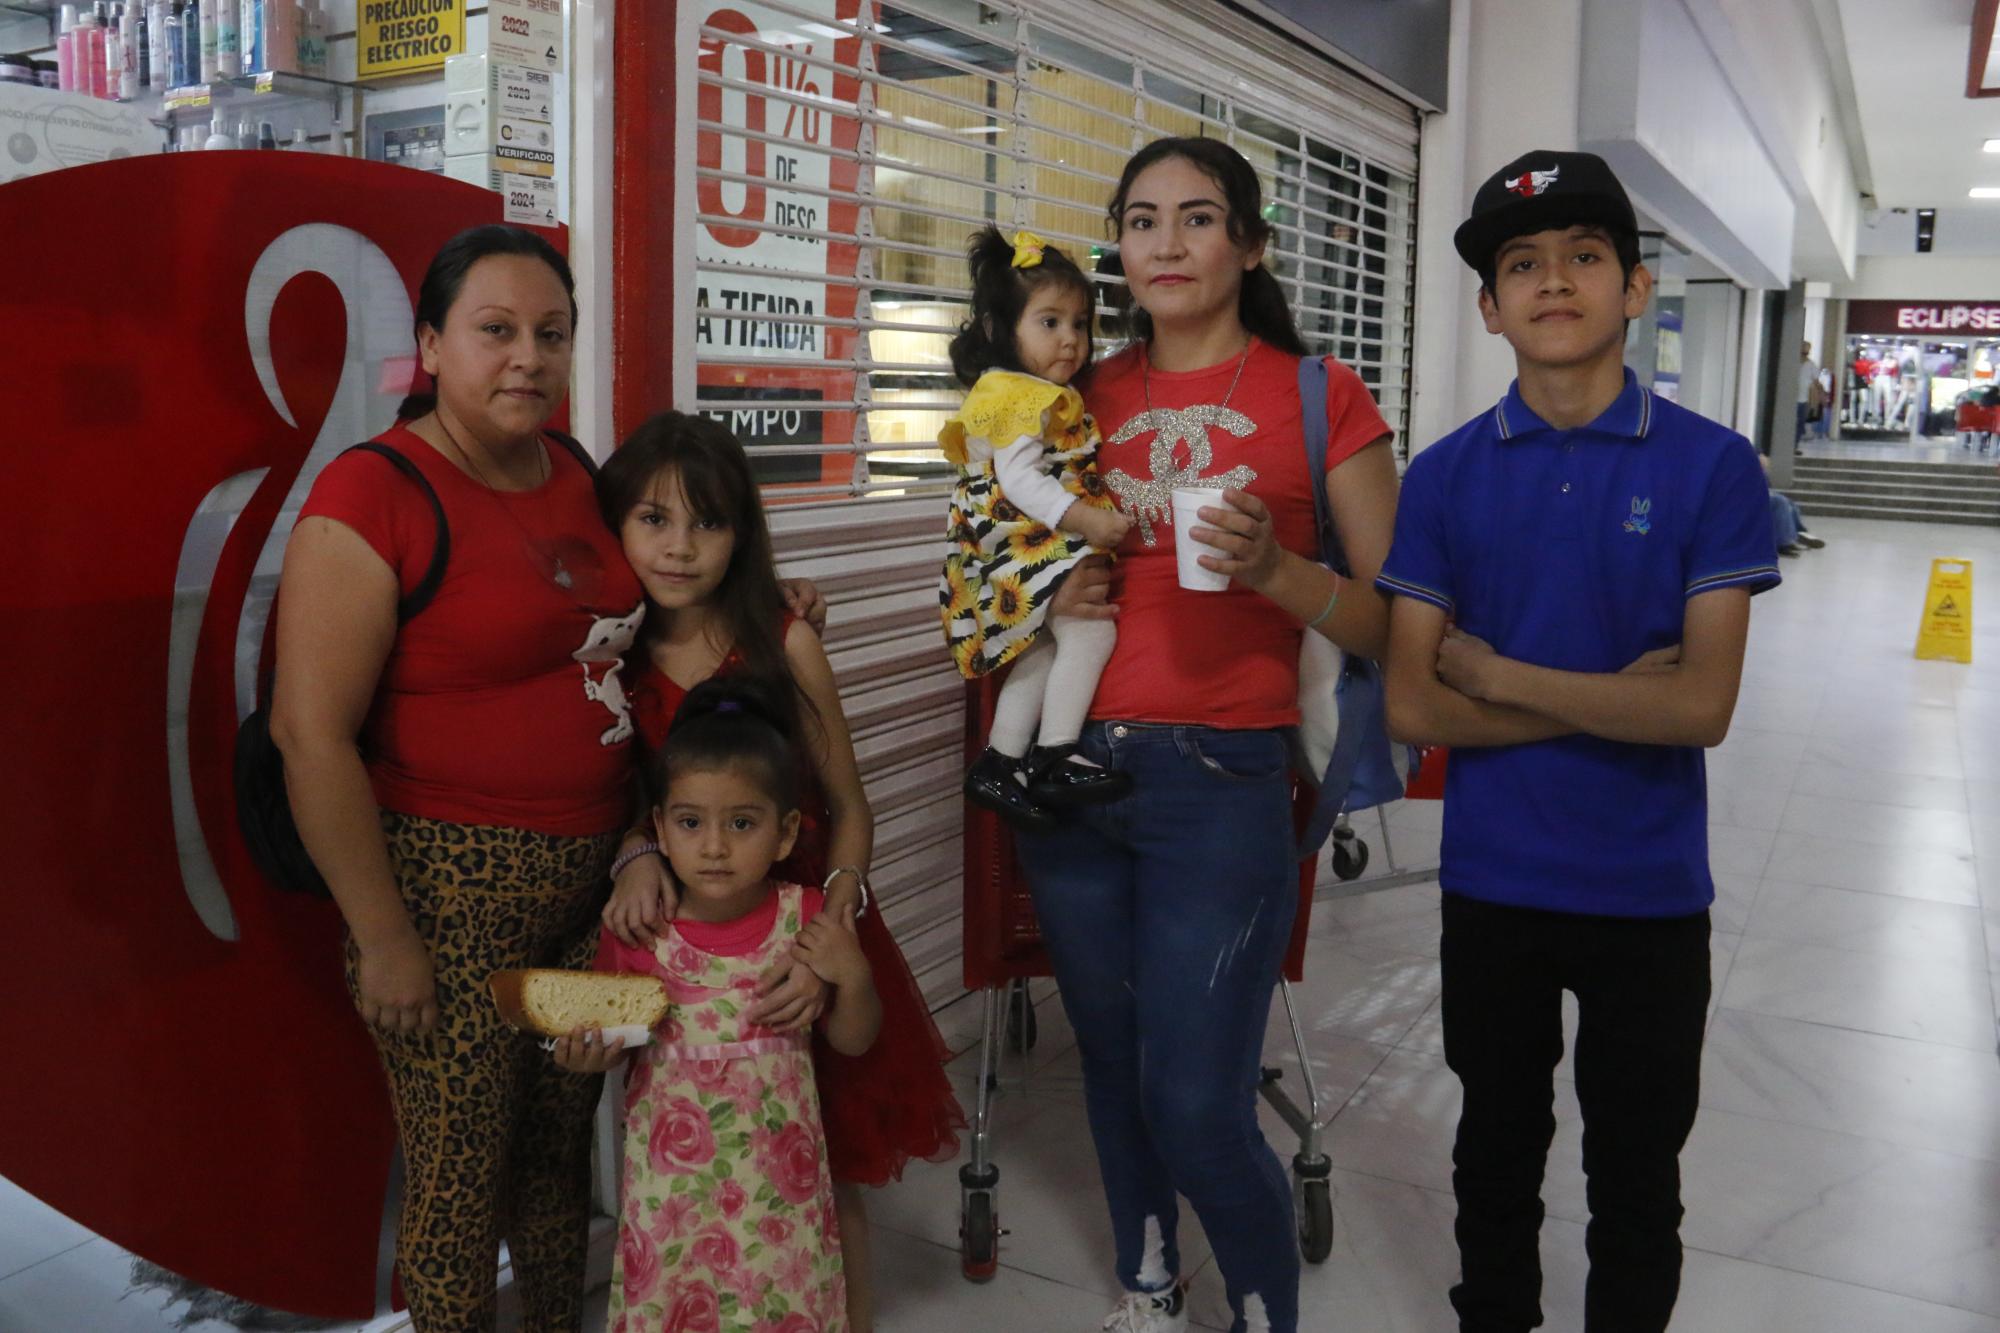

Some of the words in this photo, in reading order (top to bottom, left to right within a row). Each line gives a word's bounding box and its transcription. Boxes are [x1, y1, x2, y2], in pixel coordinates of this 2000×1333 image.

[379, 16, 439, 42] RIESGO
[501, 15, 530, 37] 2022
[367, 34, 452, 64] ELECTRICO
[497, 146, 554, 163] VERIFICADO
[775, 154, 798, 195] DE
[510, 191, 535, 209] 2024
[775, 201, 820, 245] DESC.
[720, 289, 816, 352] TIENDA
[1897, 305, 2000, 329] ECLIPSE
